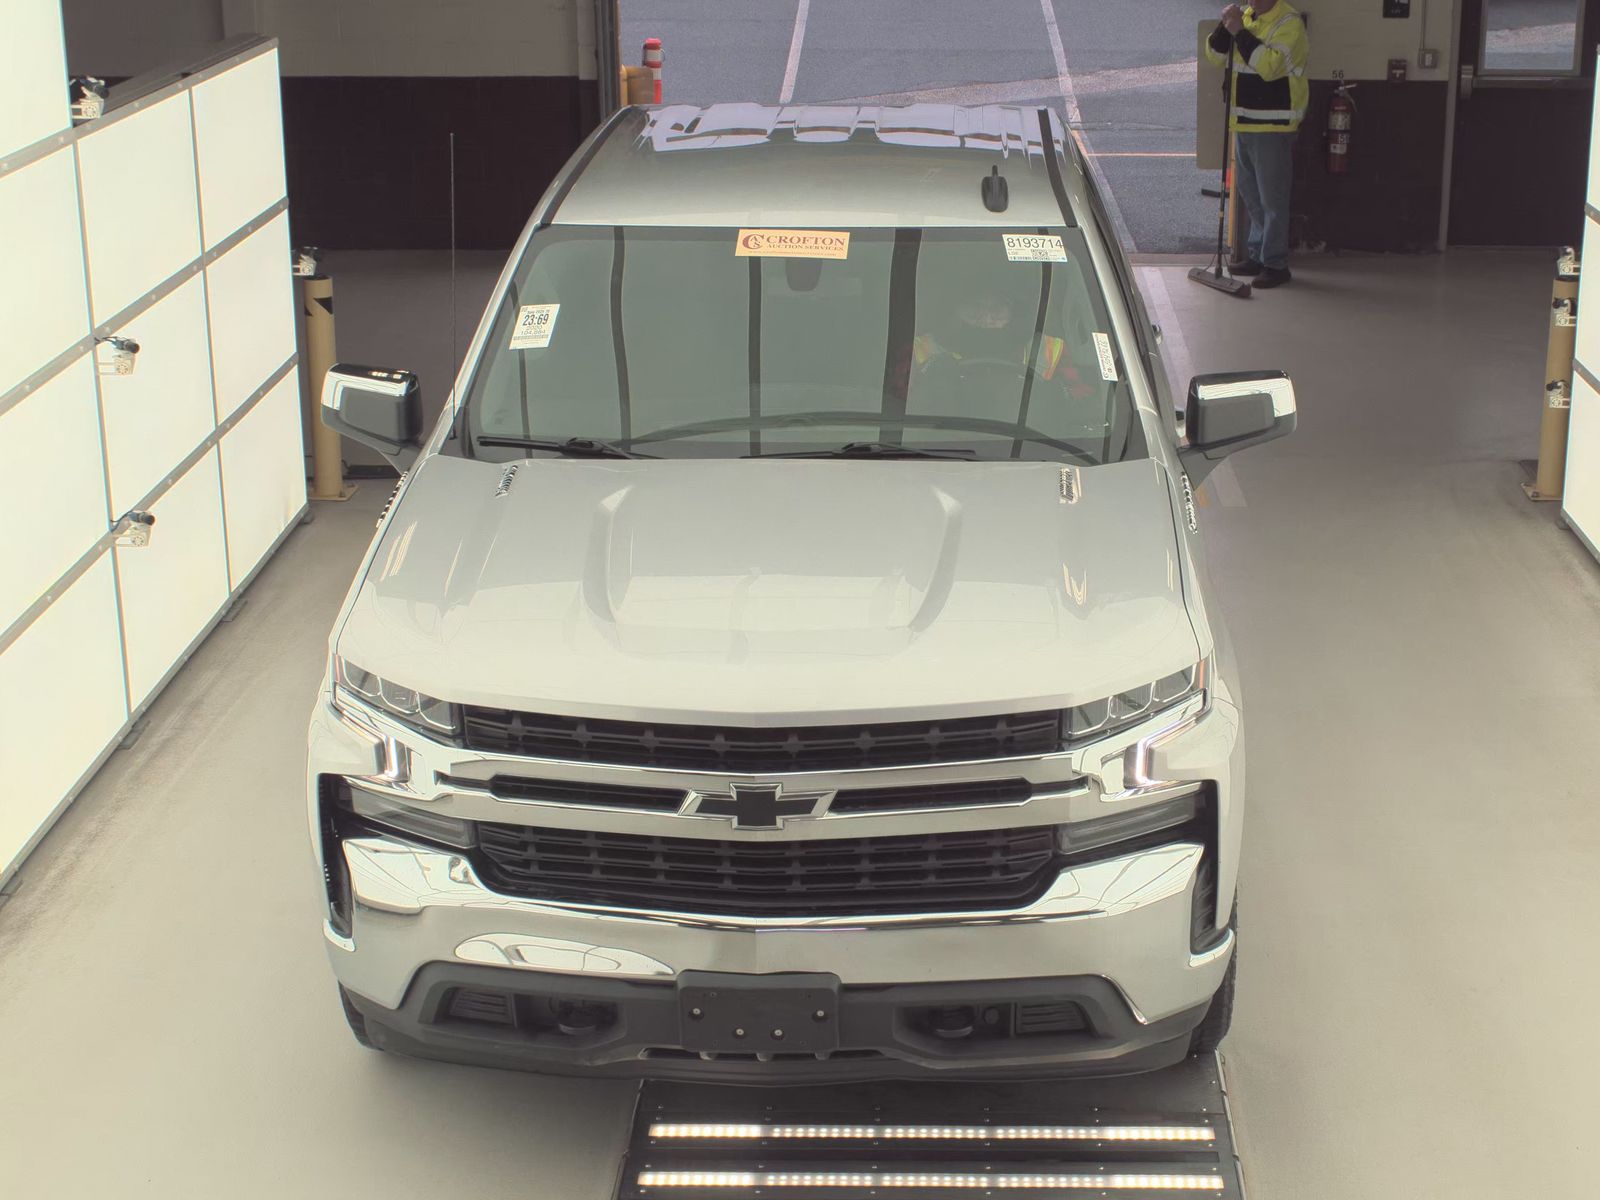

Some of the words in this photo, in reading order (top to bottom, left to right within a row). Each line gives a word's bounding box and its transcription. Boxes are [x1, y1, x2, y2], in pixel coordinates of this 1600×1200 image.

[1331, 70, 1344, 79] 56
[766, 235, 846, 246] CROFTON
[1006, 237, 1064, 249] 8193714
[522, 313, 549, 326] 23:69
